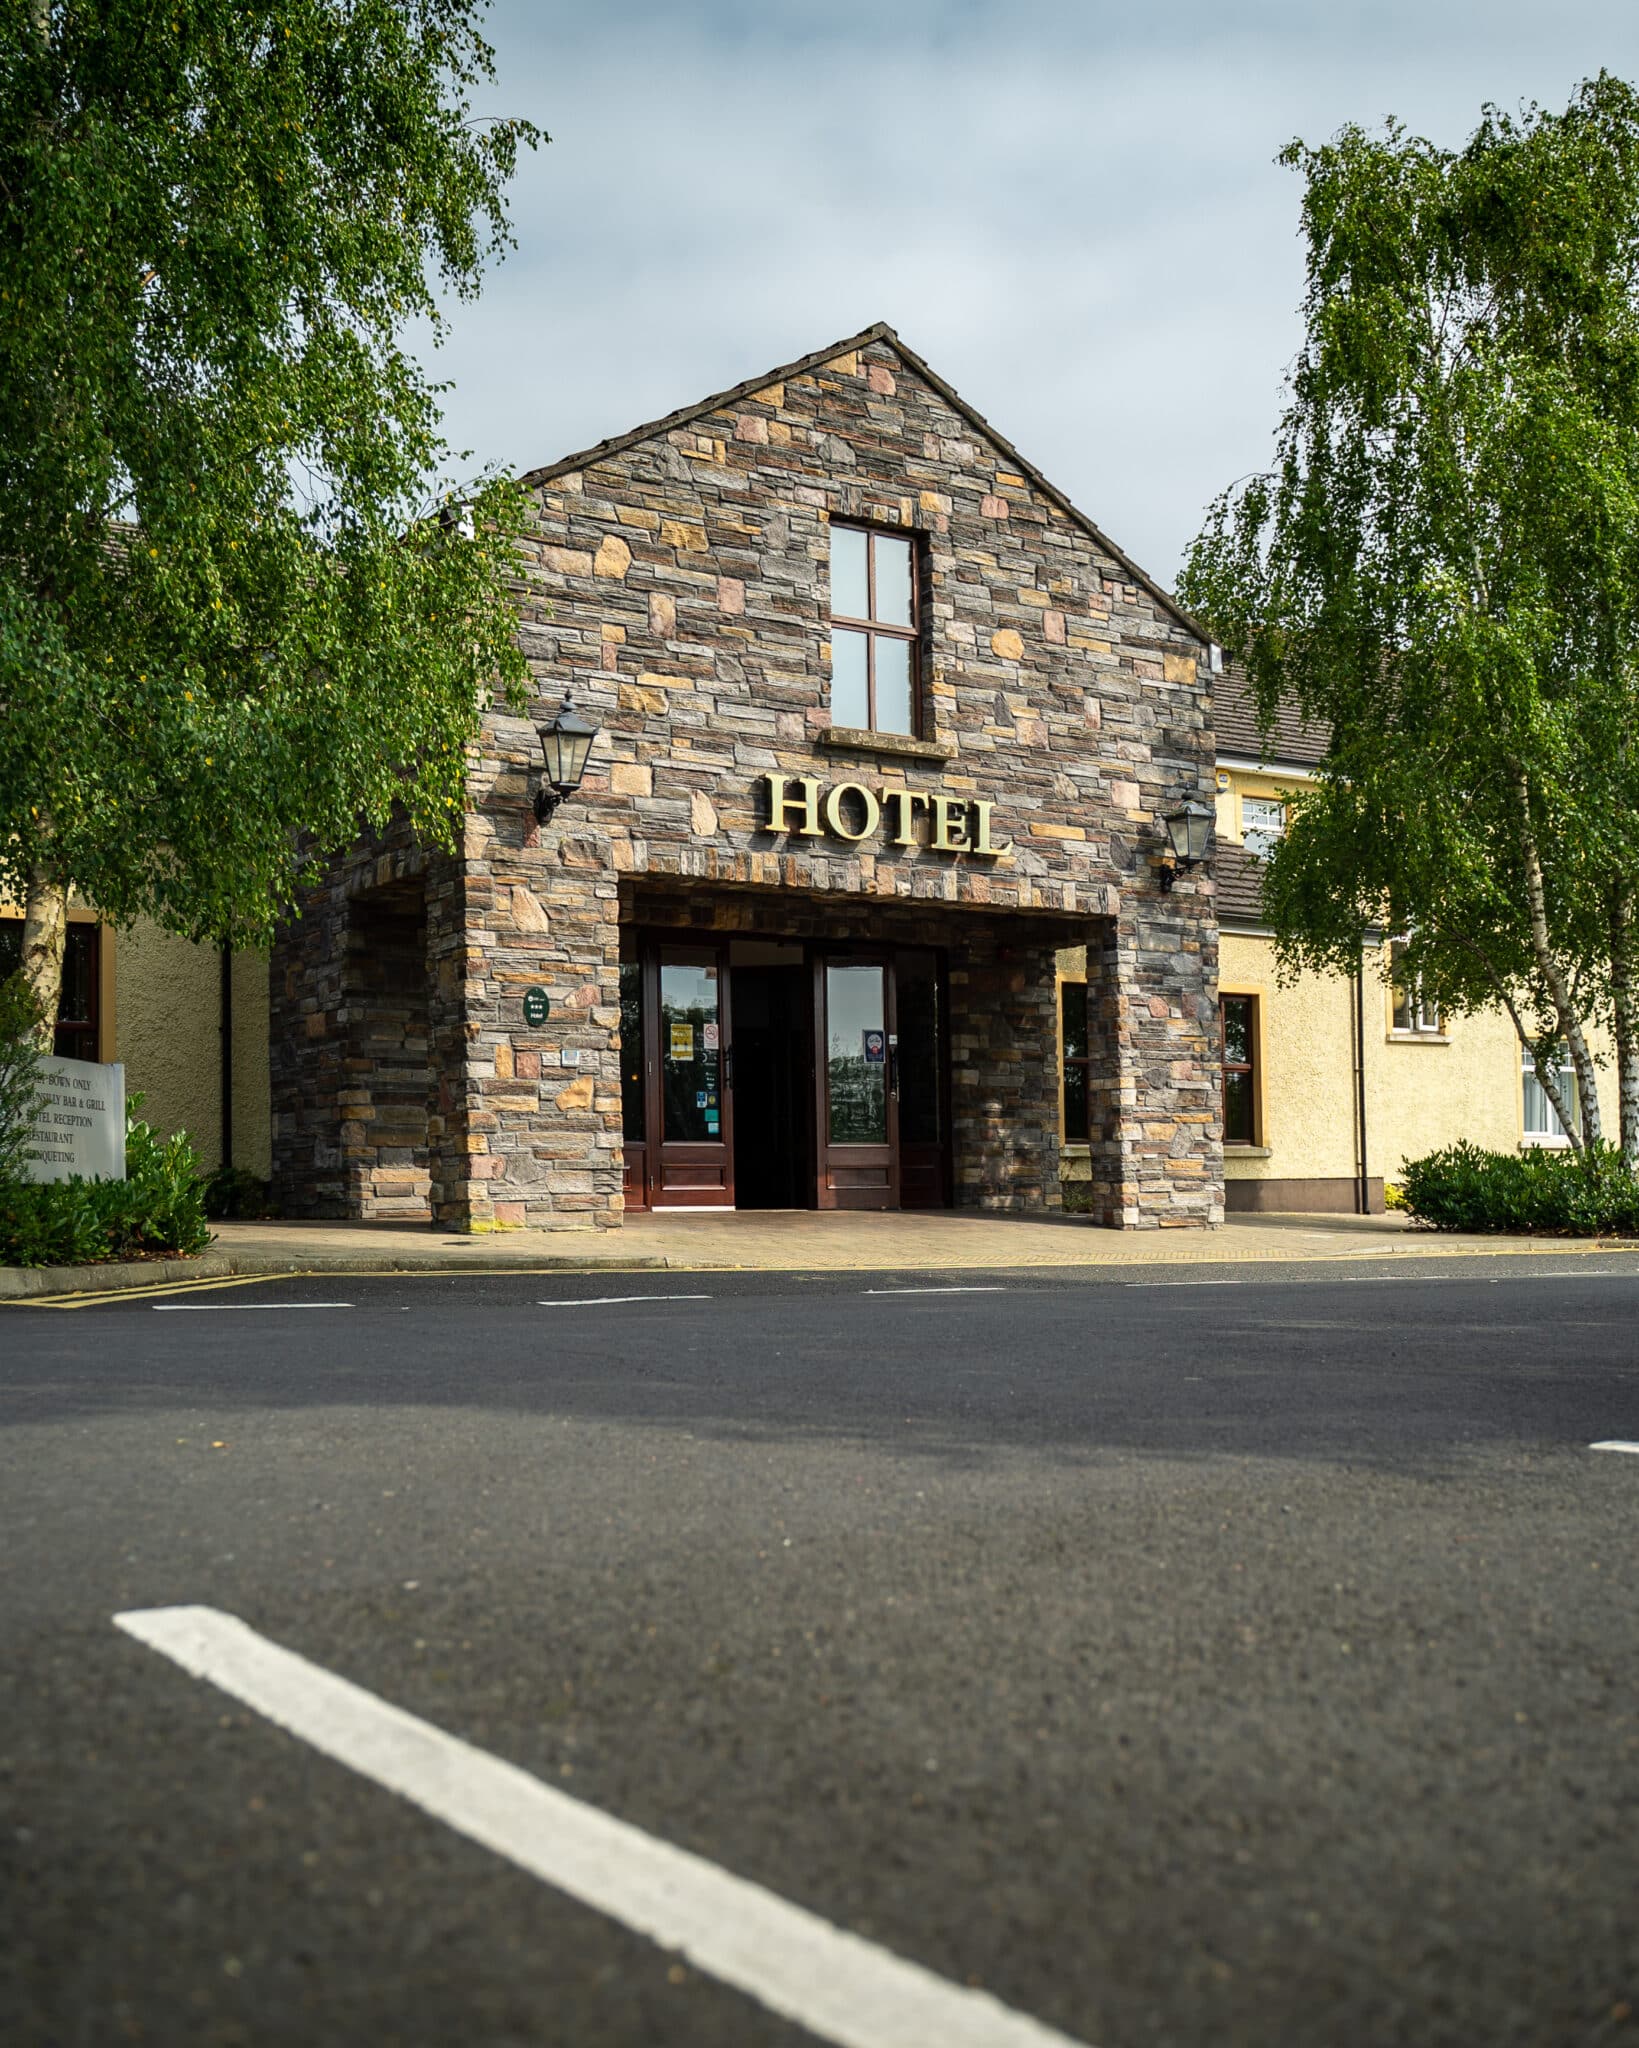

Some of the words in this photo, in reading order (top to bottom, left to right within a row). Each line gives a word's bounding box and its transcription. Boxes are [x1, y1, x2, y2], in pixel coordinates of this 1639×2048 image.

[763, 773, 1013, 856] HOTEL
[72, 1078, 91, 1091] ONLY
[63, 1095, 77, 1107] BAR
[79, 1098, 84, 1108] &
[86, 1099, 106, 1110] GRILL
[54, 1113, 93, 1127] RECEPTION
[27, 1130, 74, 1144] RESTAURANT
[27, 1149, 75, 1164] NQUETING
